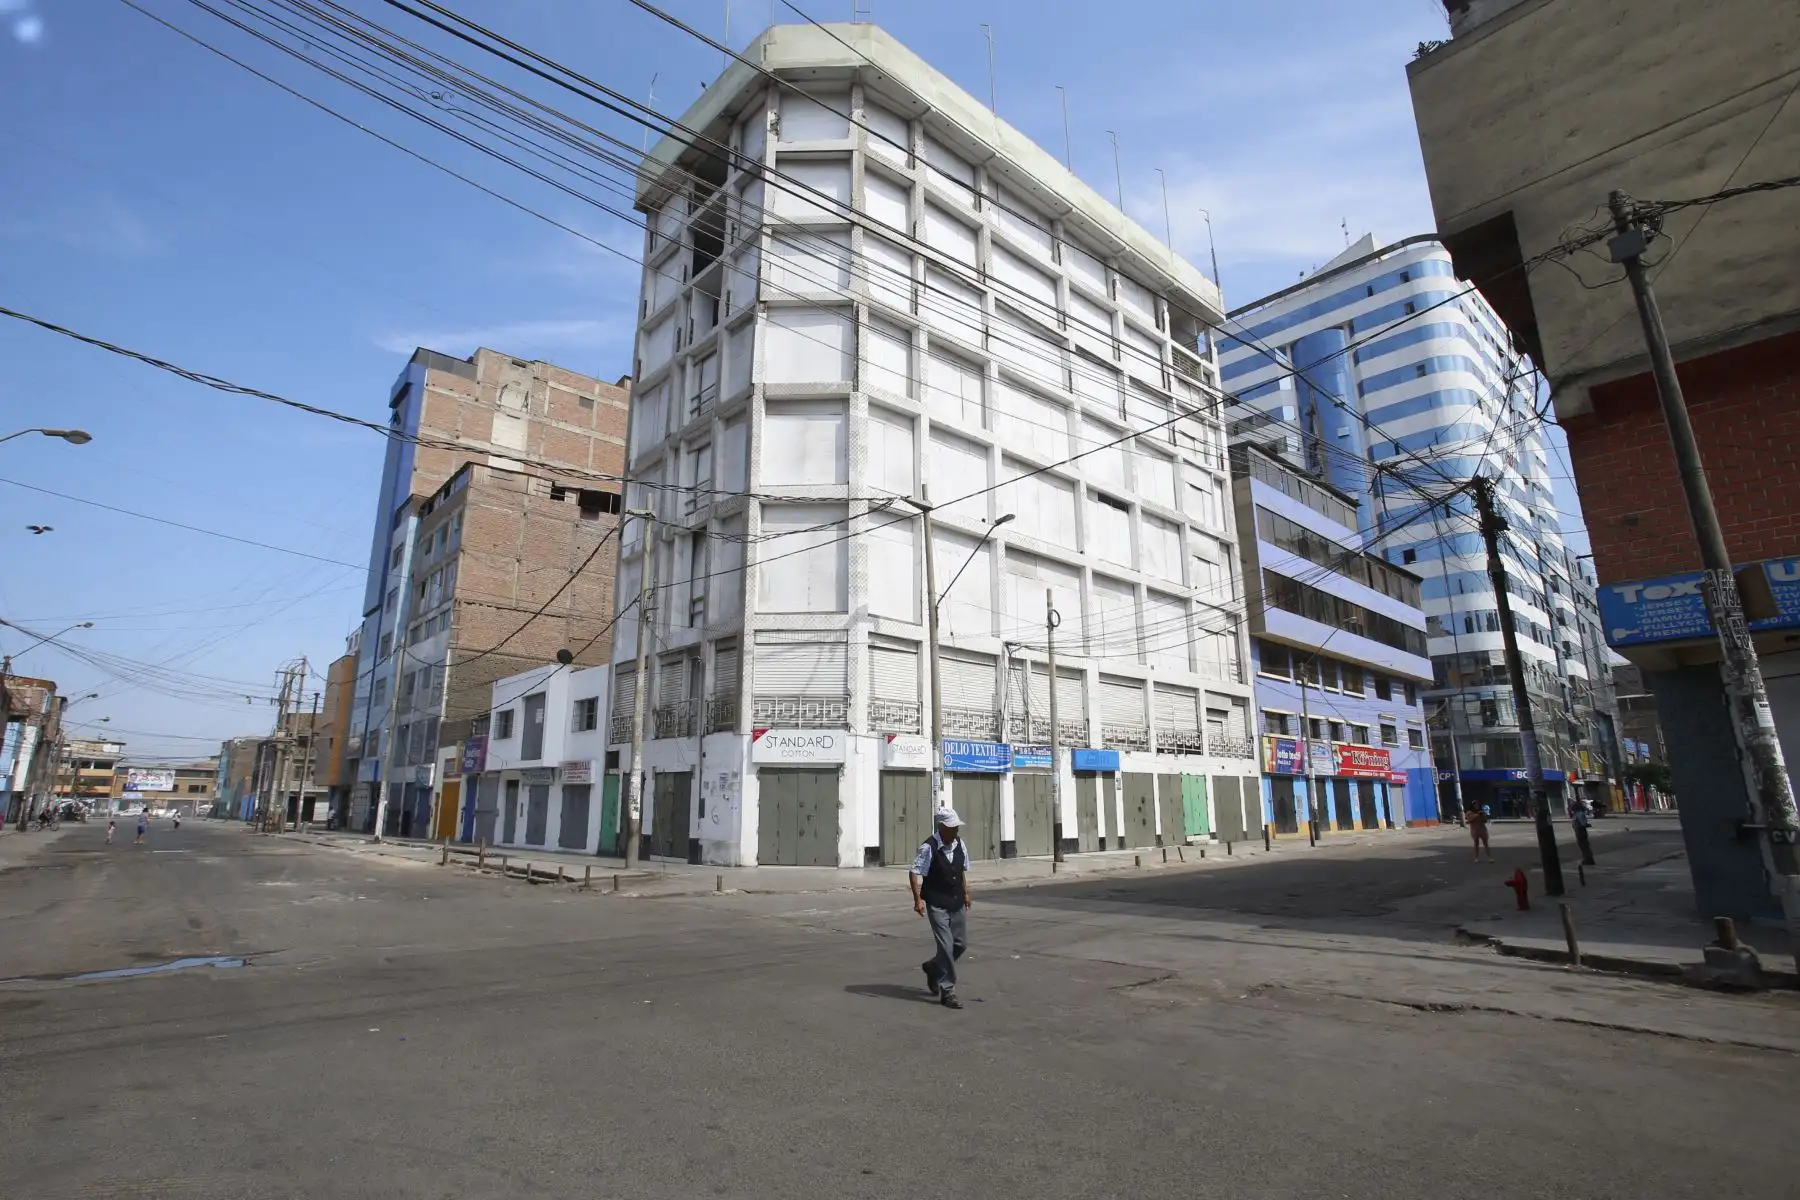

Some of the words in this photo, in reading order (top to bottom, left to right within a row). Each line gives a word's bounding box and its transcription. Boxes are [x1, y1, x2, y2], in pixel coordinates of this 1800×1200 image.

[1640, 598, 1691, 611] JERSEY
[1641, 605, 1693, 618] JERSEY
[1641, 612, 1702, 624] GAMUZA
[1643, 619, 1709, 631] FULLYCR
[1644, 626, 1701, 638] FRENSH
[766, 735, 834, 749] STANDARD
[781, 750, 815, 758] COTTON
[944, 741, 970, 756] DELIO
